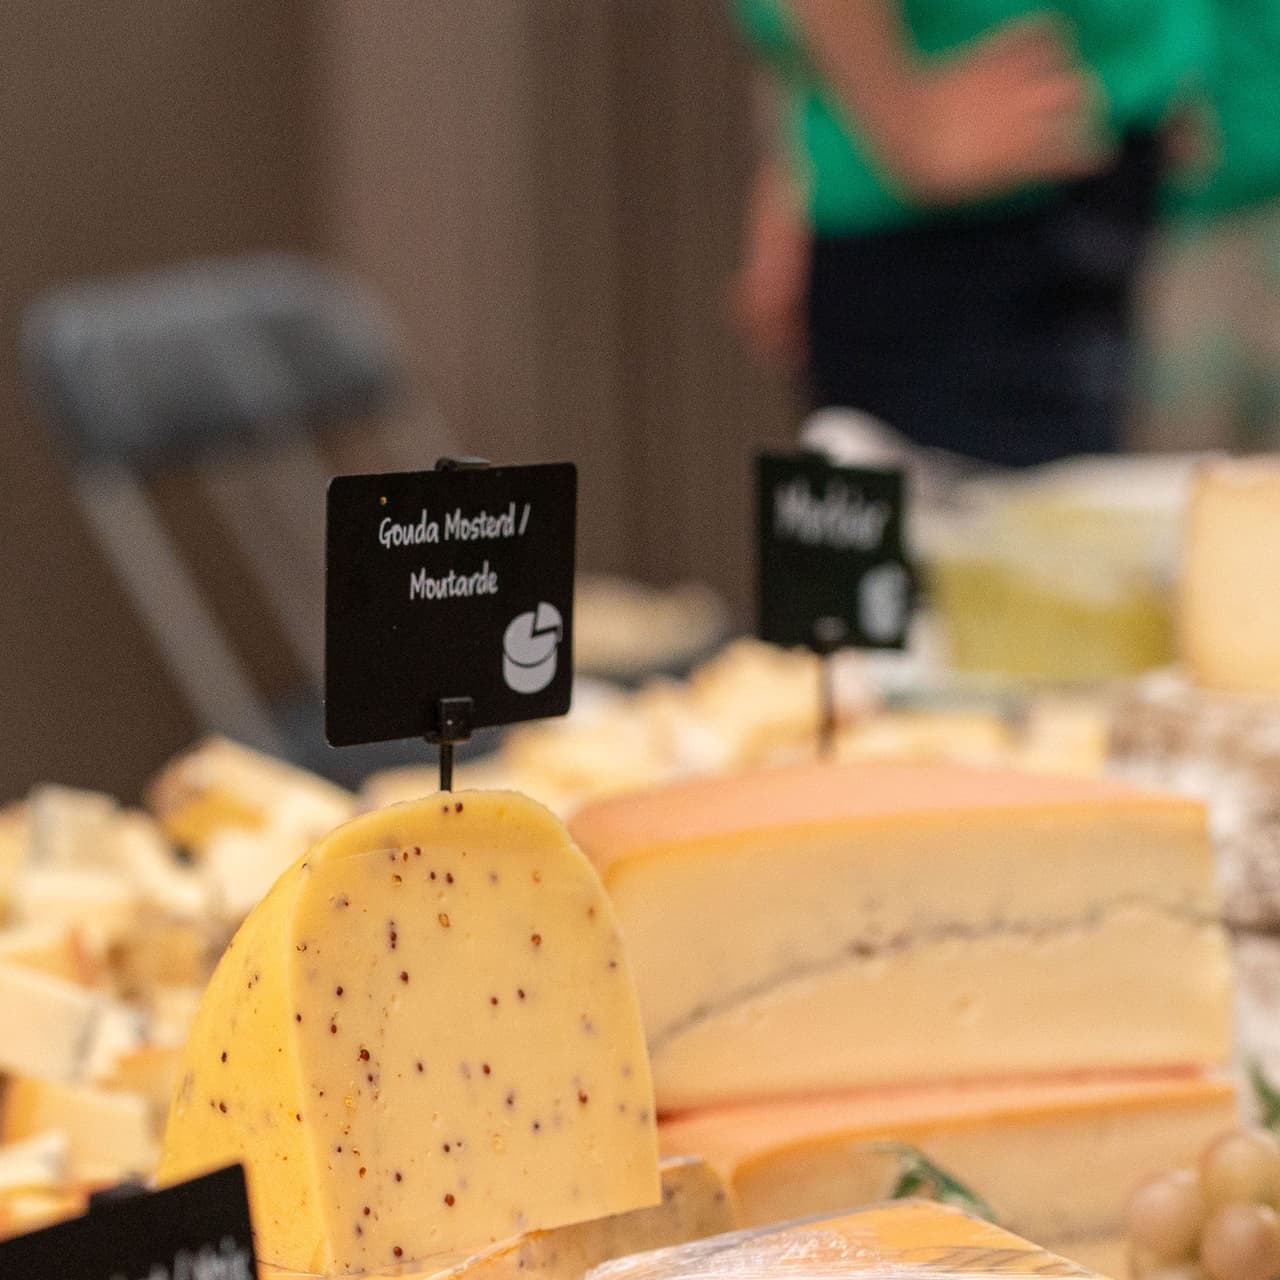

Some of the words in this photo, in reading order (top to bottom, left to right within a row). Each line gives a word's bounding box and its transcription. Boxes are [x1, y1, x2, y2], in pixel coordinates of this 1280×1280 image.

[378, 508, 440, 549] Gouda
[444, 501, 515, 542] Mosterd
[518, 503, 532, 535] /
[409, 560, 499, 600] Moutarde
